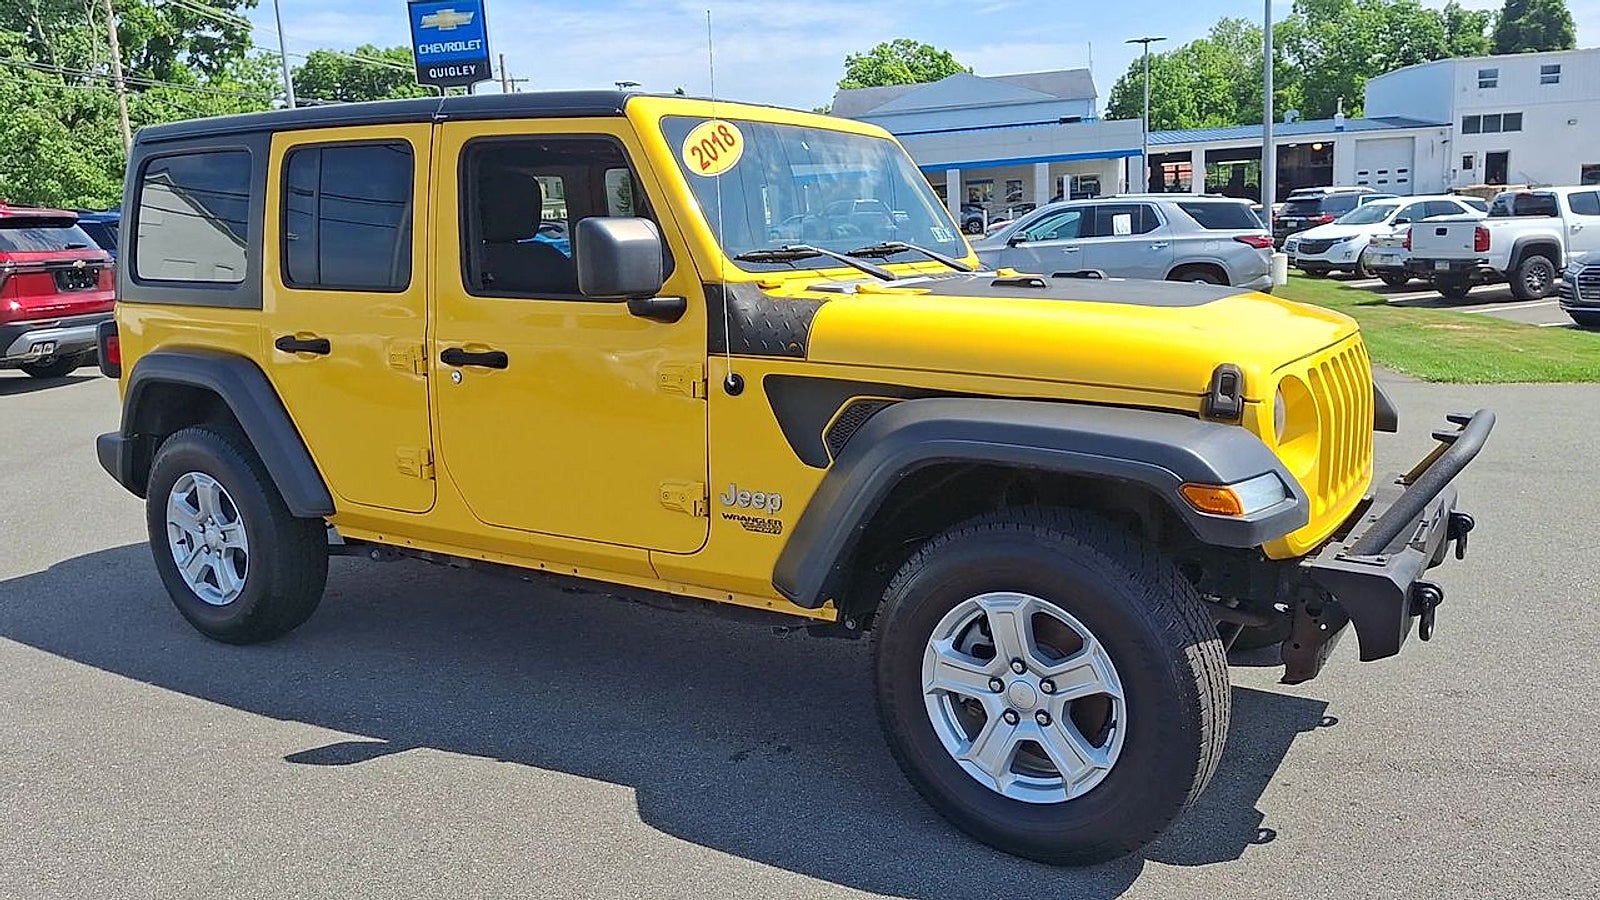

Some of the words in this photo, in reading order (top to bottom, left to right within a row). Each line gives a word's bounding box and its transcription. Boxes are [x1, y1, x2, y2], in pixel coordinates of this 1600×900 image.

[418, 39, 482, 54] CHEVROLET
[429, 64, 476, 78] QUIGLEY
[690, 124, 735, 171] 2018
[720, 482, 782, 515] Jeep
[721, 512, 783, 527] WRANGLER
